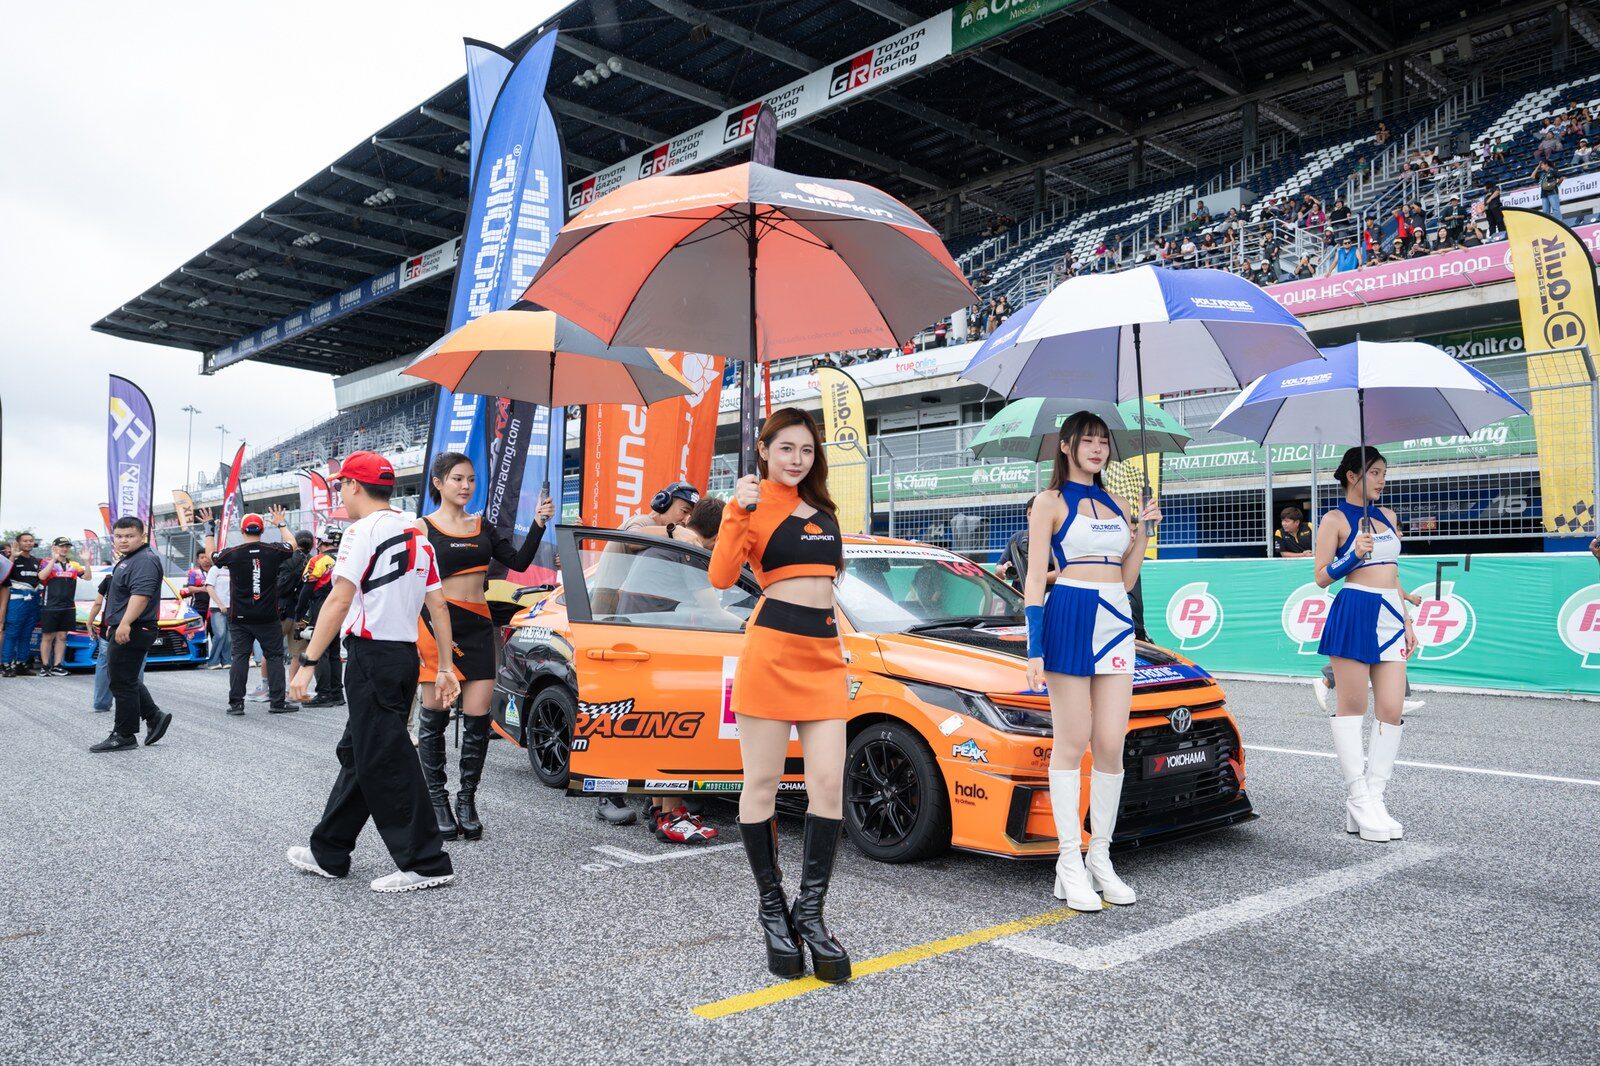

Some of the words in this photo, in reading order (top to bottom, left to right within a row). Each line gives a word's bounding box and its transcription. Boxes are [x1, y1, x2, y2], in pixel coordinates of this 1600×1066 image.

[876, 28, 926, 56] TOYOTA
[874, 42, 920, 68] GAZOO
[872, 54, 917, 79] Racing
[830, 63, 870, 97] GR
[771, 97, 799, 114] AZOO
[671, 129, 704, 148] TOYOTA
[668, 150, 698, 168] Racing
[669, 141, 699, 159] GAZOO
[597, 165, 626, 183] TOYOTA
[638, 155, 668, 179] GR
[595, 175, 622, 192] GAZOO
[569, 187, 593, 210] GR
[422, 249, 443, 262] TOYOTA
[422, 256, 440, 268] GAZOO
[1283, 288, 1315, 306] OUR
[1393, 265, 1434, 285] INTO
[1440, 255, 1491, 277] FOOD
[1438, 336, 1523, 359] axnitro
[904, 474, 939, 490] Chang
[990, 466, 1031, 484] Chang
[937, 559, 984, 577] 169
[1180, 598, 1210, 636] PT
[1416, 600, 1459, 643] PT
[572, 712, 705, 737] RACING
[952, 743, 989, 764] PEAK
[1166, 750, 1206, 768] YOKOHAMA
[954, 781, 988, 801] halo.
